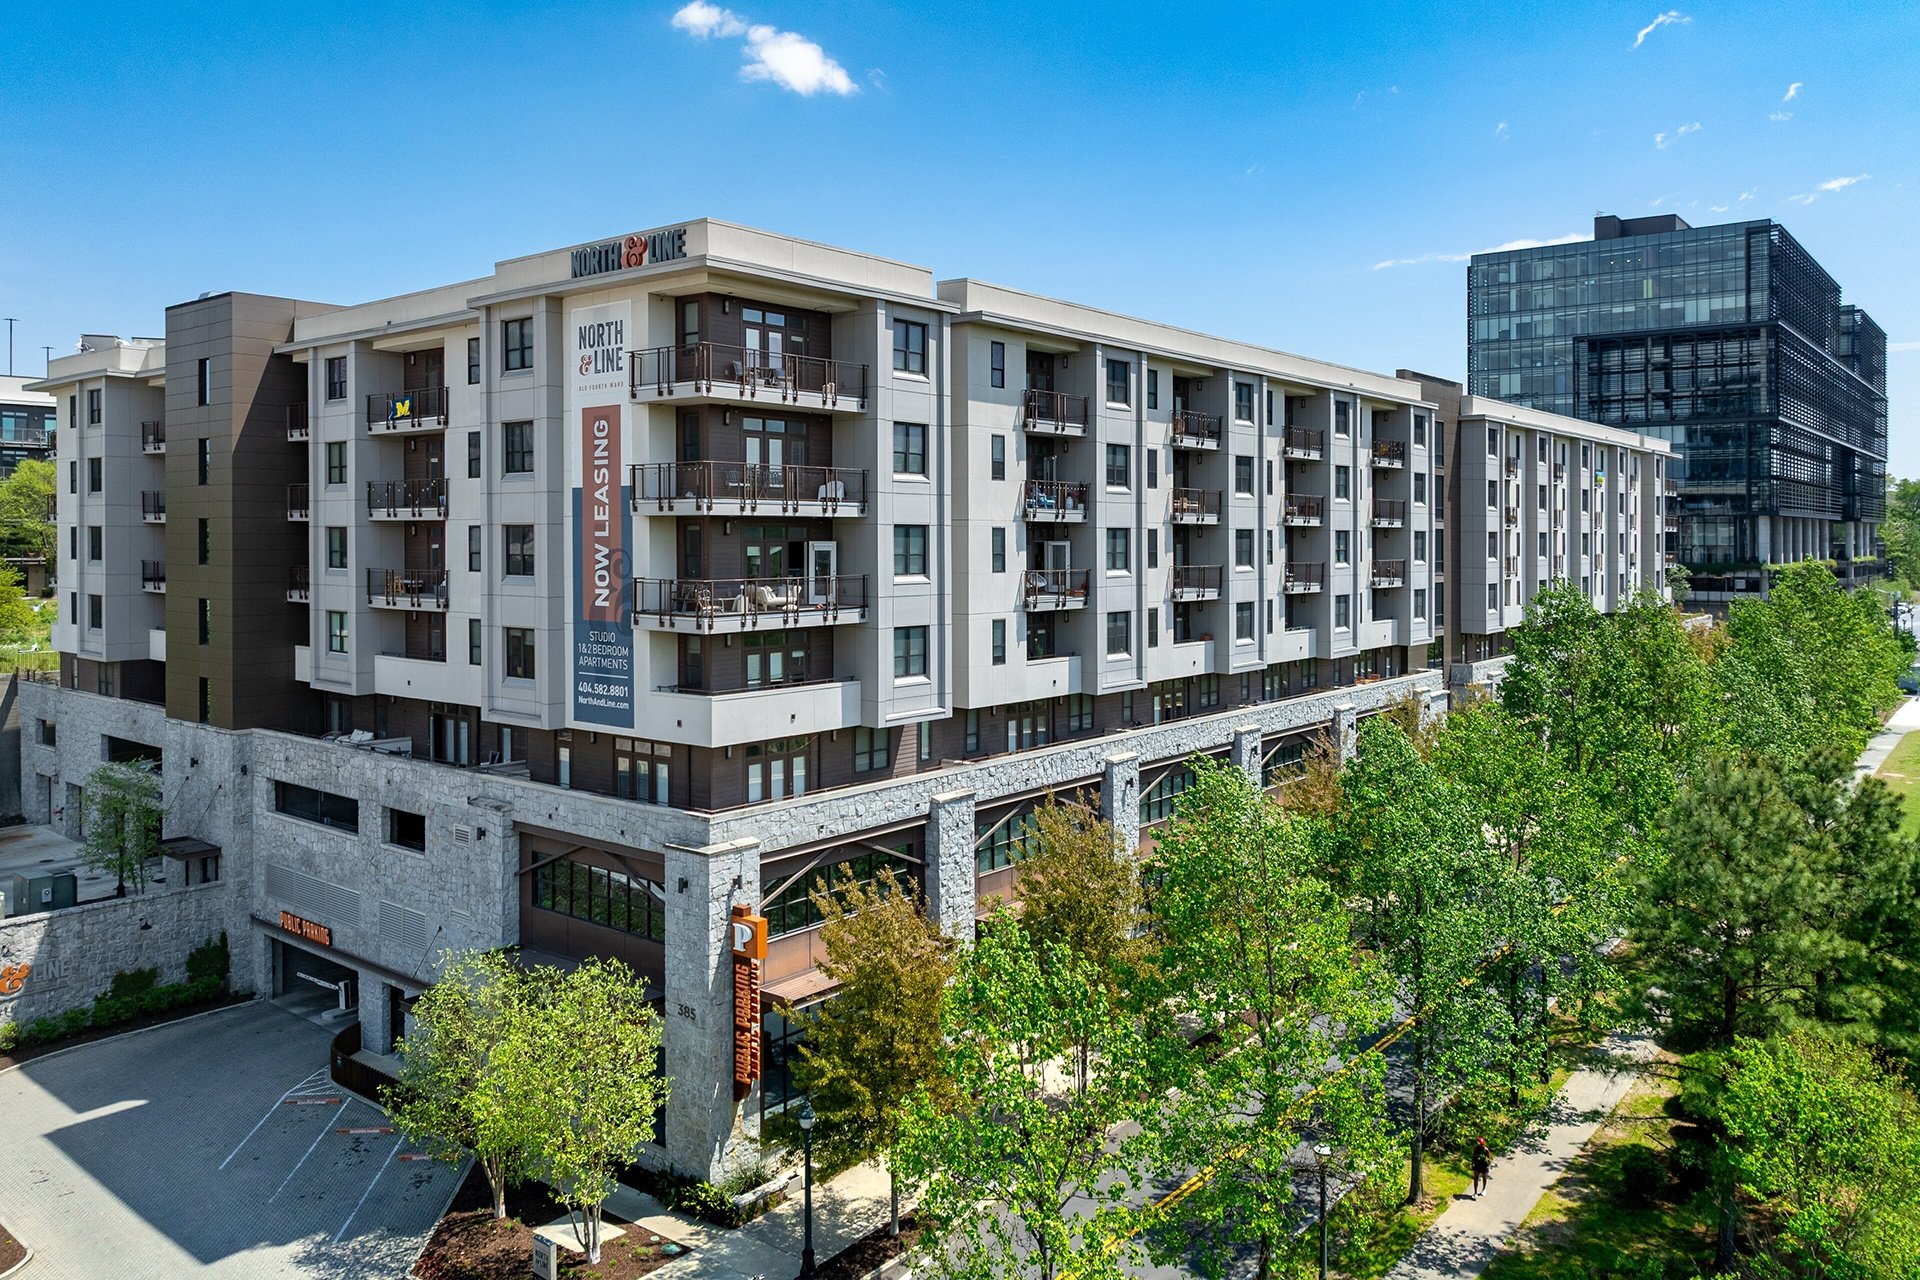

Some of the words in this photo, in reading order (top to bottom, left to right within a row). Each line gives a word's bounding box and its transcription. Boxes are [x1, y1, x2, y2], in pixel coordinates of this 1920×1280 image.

[571, 242, 622, 278] NORTH
[621, 236, 648, 269] &
[648, 228, 687, 264] LINE
[578, 319, 623, 350] NORTH
[578, 354, 593, 376] &
[594, 346, 623, 374] LINE
[578, 384, 587, 392] OLD
[394, 399, 410, 418] M
[593, 419, 609, 537] LEASING
[594, 543, 610, 607] NOW
[589, 630, 616, 643] STUDIO
[579, 656, 628, 670] APARTMENTS
[593, 644, 629, 657] BEDROOM
[578, 682, 628, 697] 404.582.8801
[578, 695, 629, 710] NorthAndLine.com
[280, 911, 301, 934] PUBLIC
[302, 920, 330, 946] PARKING
[732, 922, 753, 952] P
[33, 959, 70, 982] LINE
[735, 963, 751, 1028] PARKING
[677, 1003, 697, 1020] 385
[735, 1030, 751, 1085] PUBLIC
